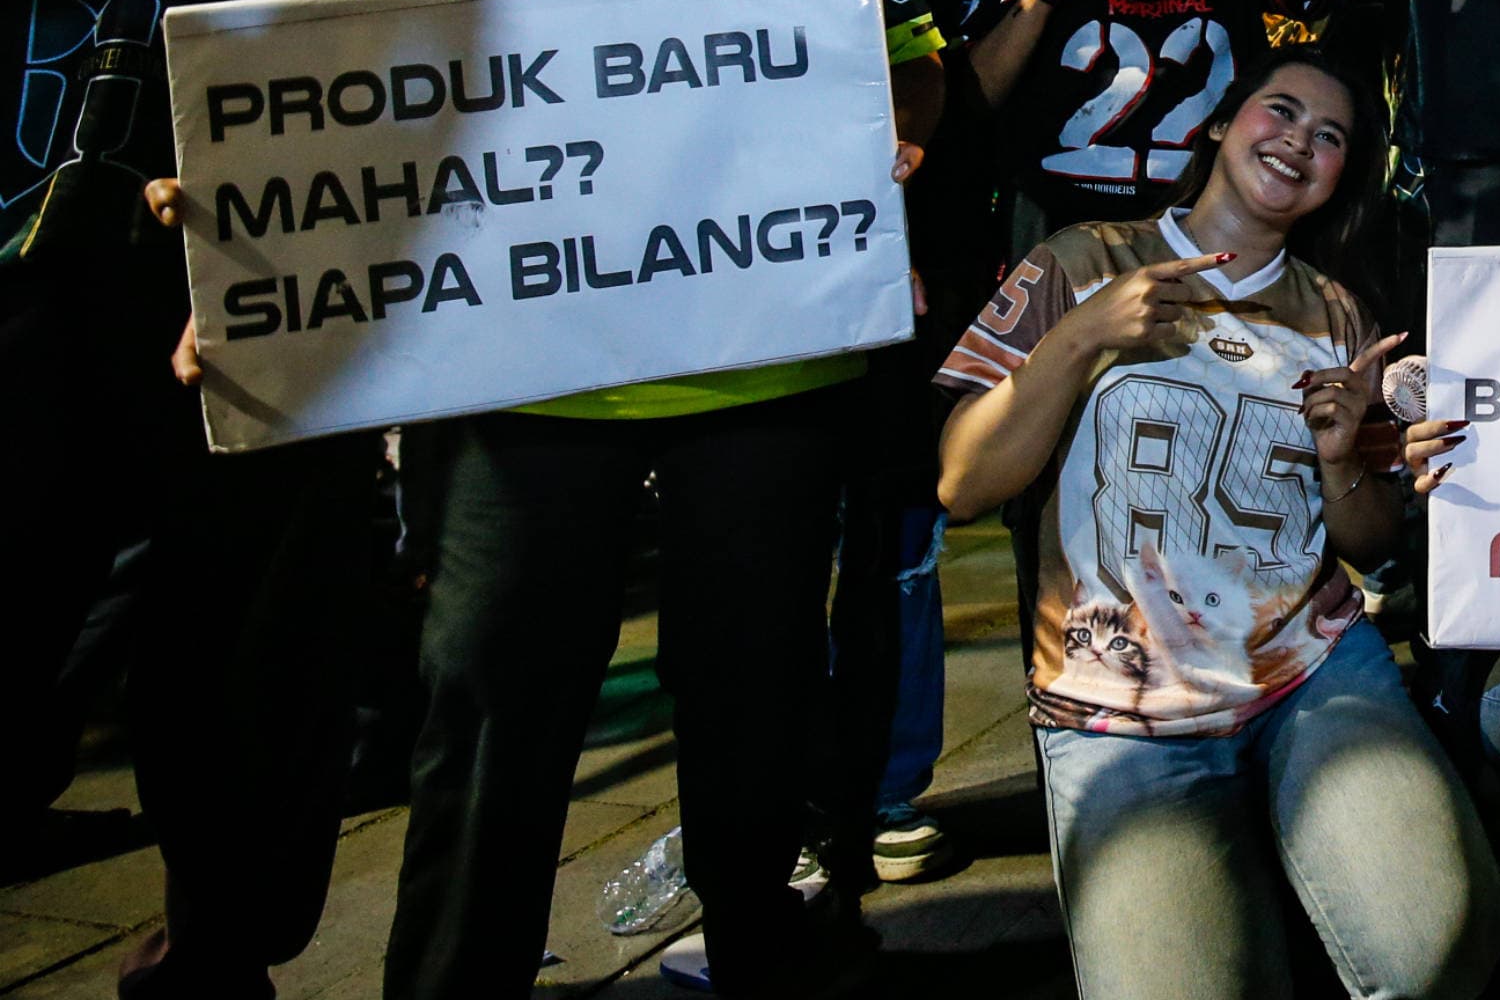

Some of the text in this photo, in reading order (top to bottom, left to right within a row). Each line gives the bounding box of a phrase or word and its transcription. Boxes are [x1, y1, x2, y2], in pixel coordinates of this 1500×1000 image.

[205, 49, 566, 143] PRODUK
[593, 25, 810, 99] BARU
[1041, 17, 1237, 181] 22
[214, 140, 604, 242] MAHAL??
[223, 199, 877, 342] SIAPA BILANG??
